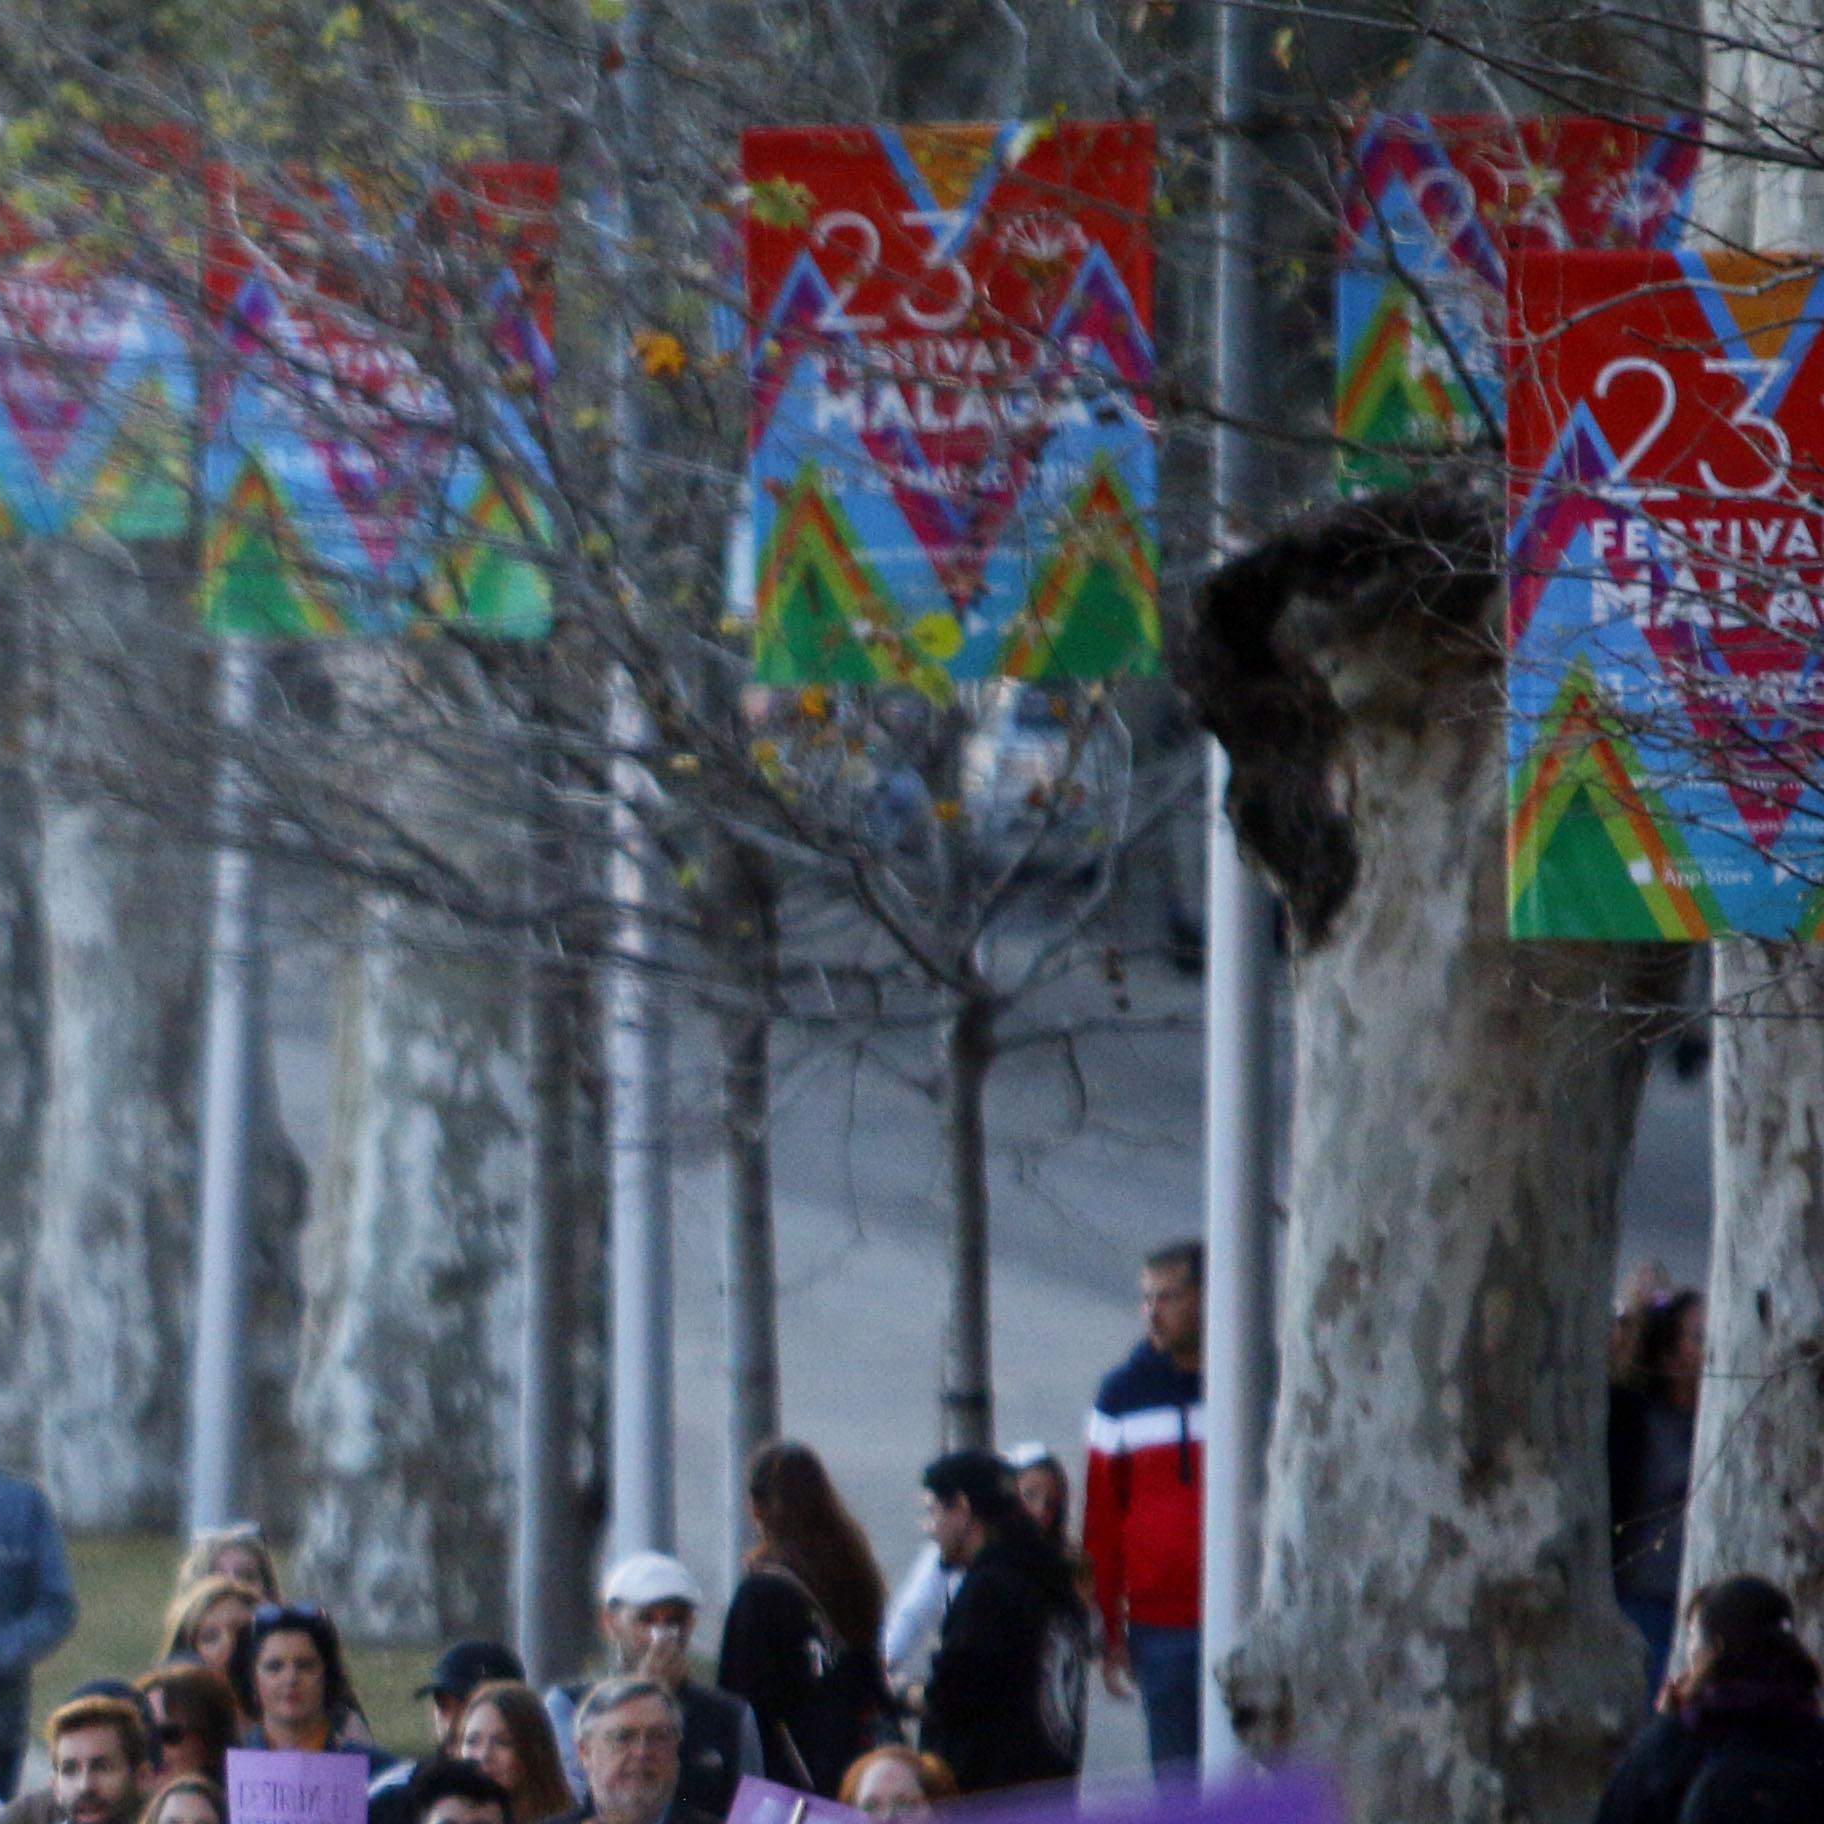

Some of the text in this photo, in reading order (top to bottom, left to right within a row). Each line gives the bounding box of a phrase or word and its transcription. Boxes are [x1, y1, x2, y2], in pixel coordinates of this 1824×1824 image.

[813, 210, 974, 332] 23
[1593, 356, 1794, 502] 23
[1590, 517, 1824, 560] FESTIVA
[1590, 565, 1824, 630] MALA
